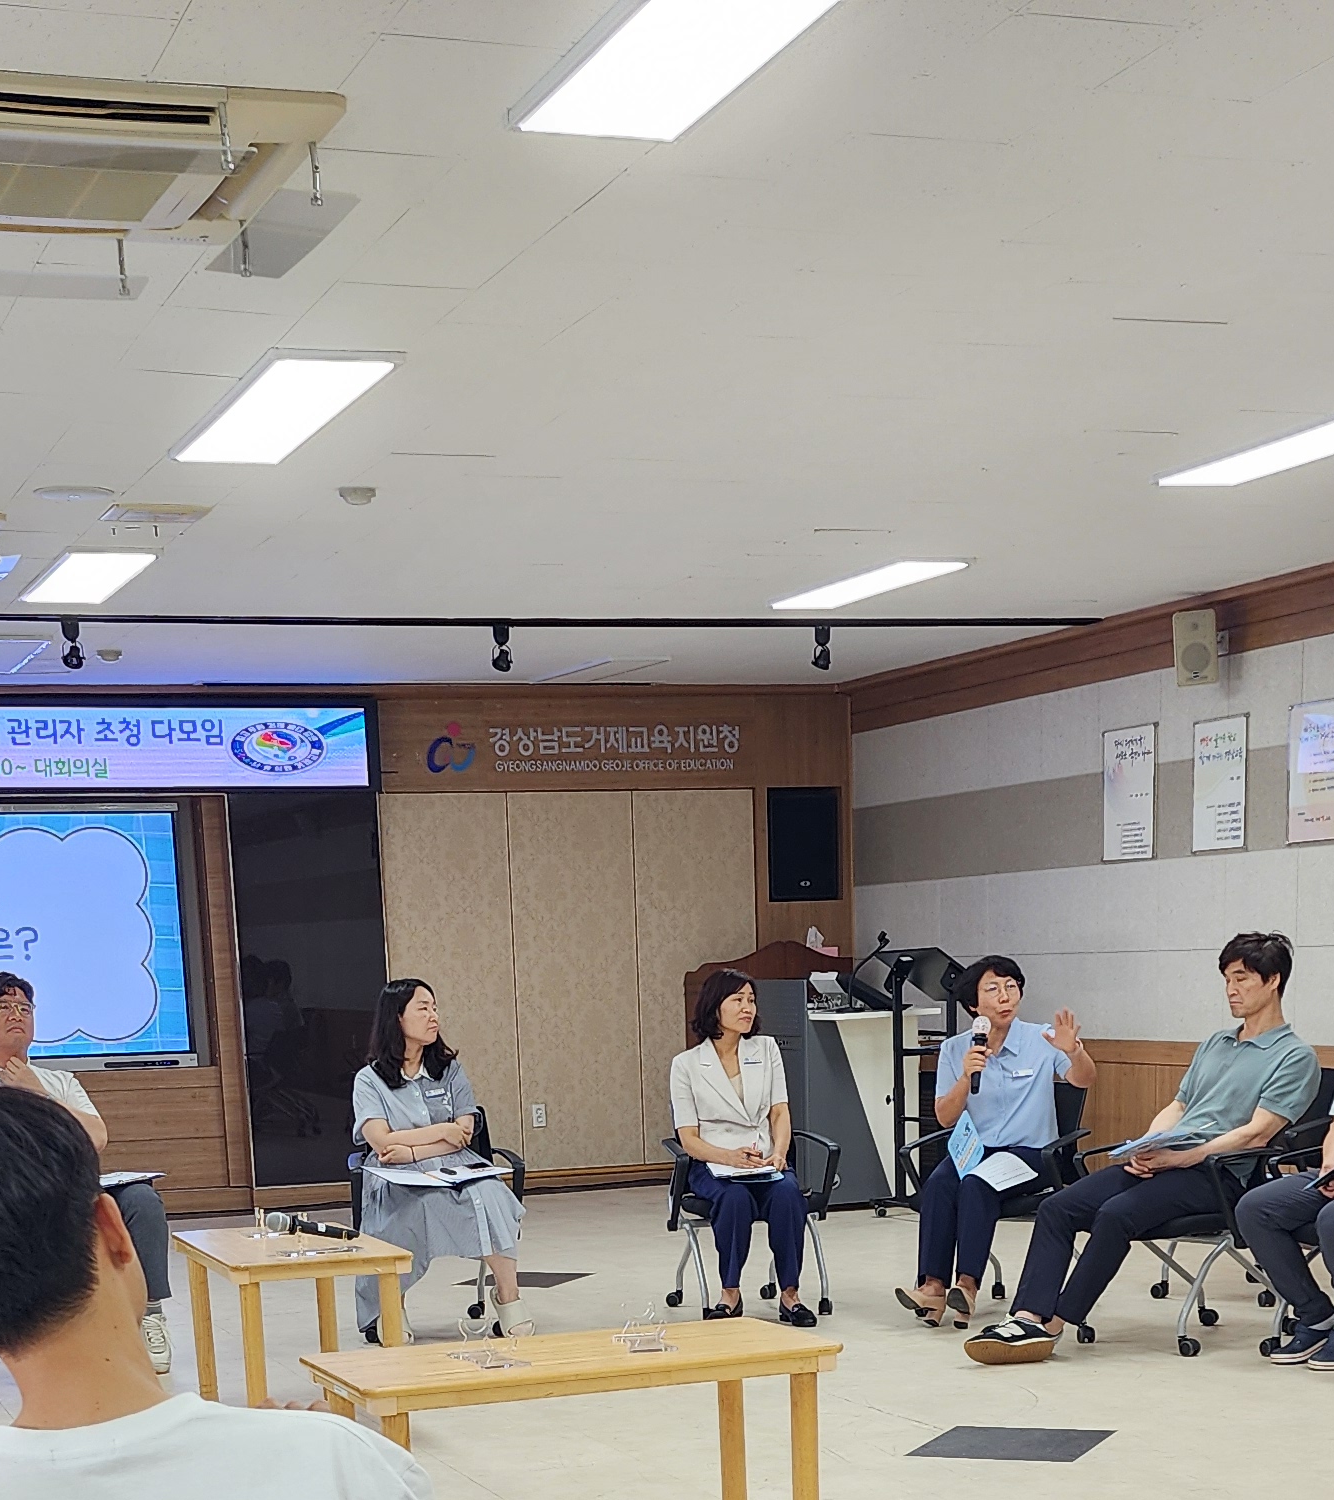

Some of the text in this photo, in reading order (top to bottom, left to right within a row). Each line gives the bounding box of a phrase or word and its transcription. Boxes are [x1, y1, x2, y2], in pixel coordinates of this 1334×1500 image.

[6, 718, 86, 746] 관리자
[94, 717, 142, 747] 초청
[150, 718, 224, 747] 다모임
[488, 723, 741, 757] 경상남도거제교육지원청
[34, 757, 109, 779] 대회의실
[495, 759, 734, 773] GYEONGSANGNAMDO GEOJE OFFICE OF EDUCATION
